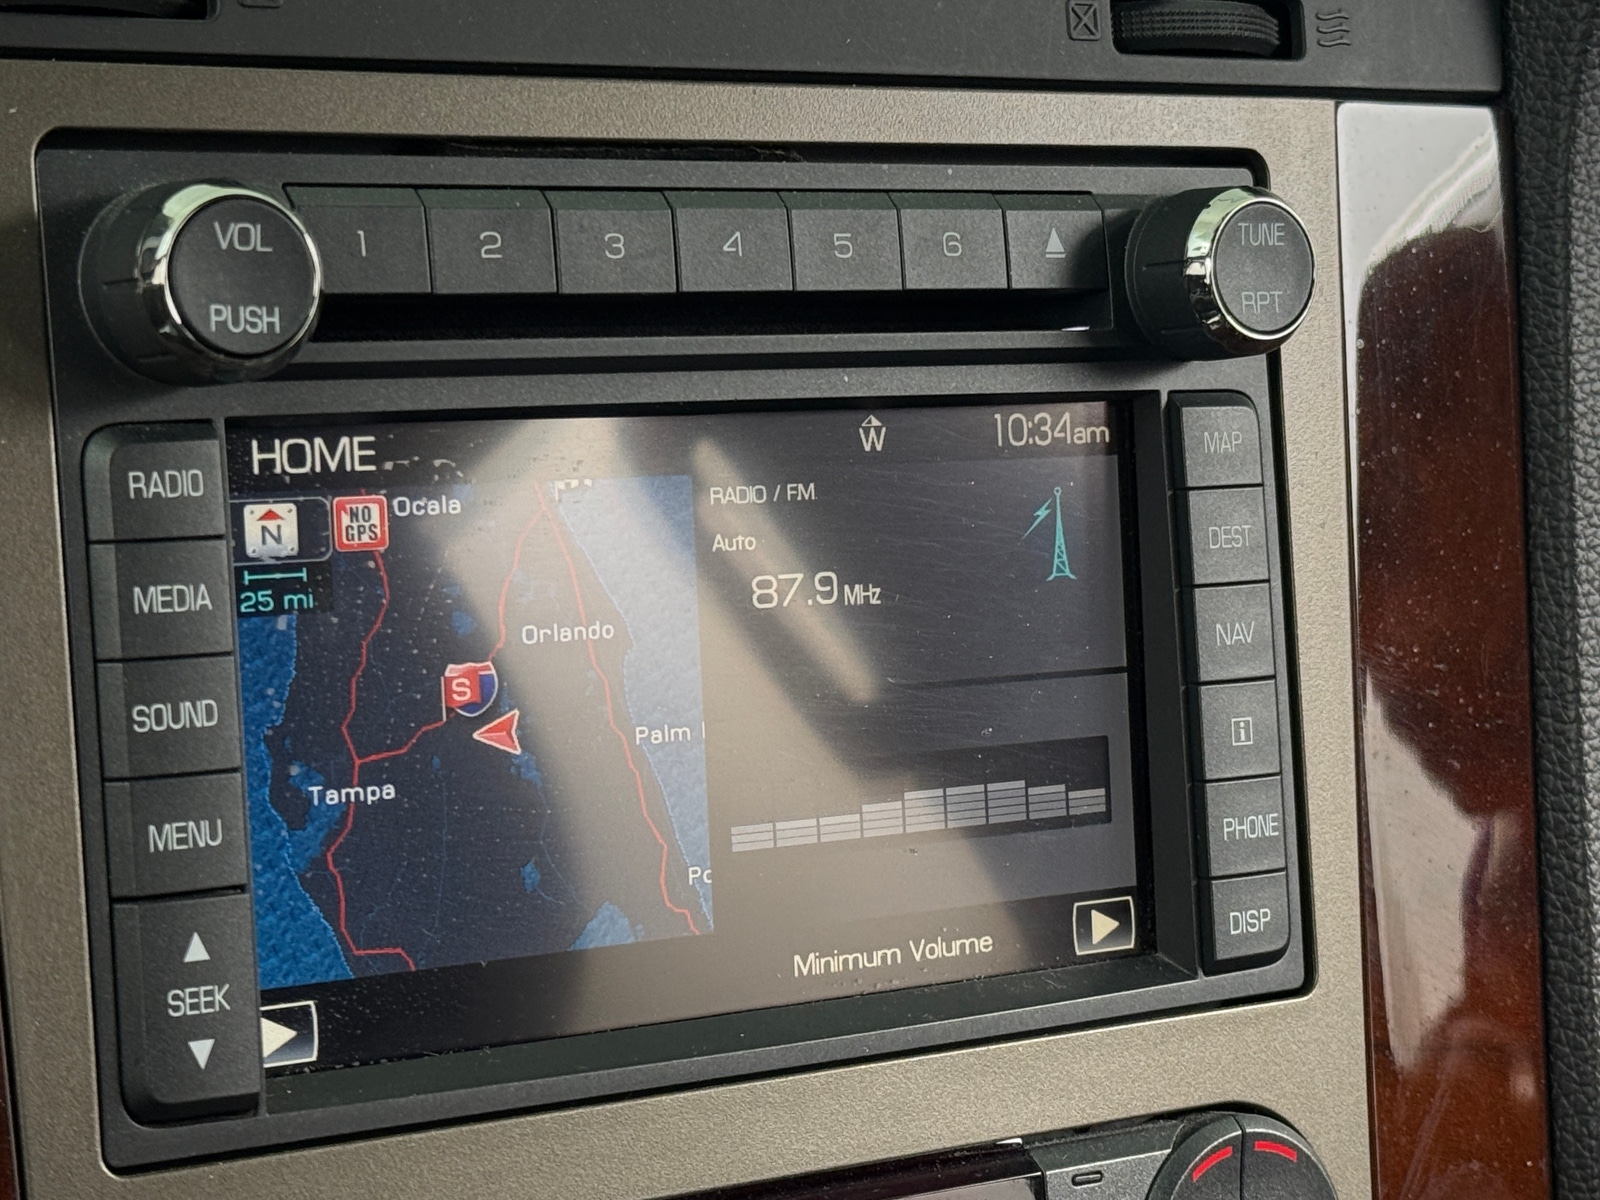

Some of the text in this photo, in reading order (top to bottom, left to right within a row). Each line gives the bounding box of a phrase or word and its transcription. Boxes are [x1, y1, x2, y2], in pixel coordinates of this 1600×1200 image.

[213, 220, 273, 252] VOL
[357, 230, 366, 257] 1
[479, 231, 503, 259] 2
[604, 232, 625, 259] 3
[722, 231, 743, 257] 4
[833, 232, 853, 259] 5
[942, 231, 962, 257] 6
[1237, 222, 1285, 246] TUNE
[1241, 290, 1283, 314] RPT
[209, 303, 280, 334] PUSH
[858, 426, 886, 452] W
[994, 411, 1110, 447] 10:34am
[250, 435, 377, 475] HOME
[1203, 431, 1243, 454] MAP
[128, 469, 204, 499] RADIO
[709, 485, 767, 506] RADIO
[786, 482, 816, 501] FM
[350, 506, 372, 523] NO
[392, 495, 462, 517] Ocala
[261, 524, 283, 546] N
[345, 523, 379, 542] GPS
[712, 533, 757, 552] Auto
[1208, 524, 1251, 549] DEST
[133, 583, 213, 615] MEDIA
[240, 588, 315, 613] 25 mi
[751, 570, 882, 609] 87.9 MHz
[521, 620, 615, 645] Orlando
[1215, 621, 1255, 646] NAV
[451, 677, 472, 702] S
[132, 699, 219, 733] SOUND
[635, 724, 692, 746] Palm
[308, 782, 396, 806] Tampa
[147, 818, 223, 853] MENU
[1223, 812, 1280, 841] PHONE
[1229, 908, 1271, 935] DISP
[793, 935, 994, 978] Minimum Volume
[166, 984, 231, 1017] SEEK
